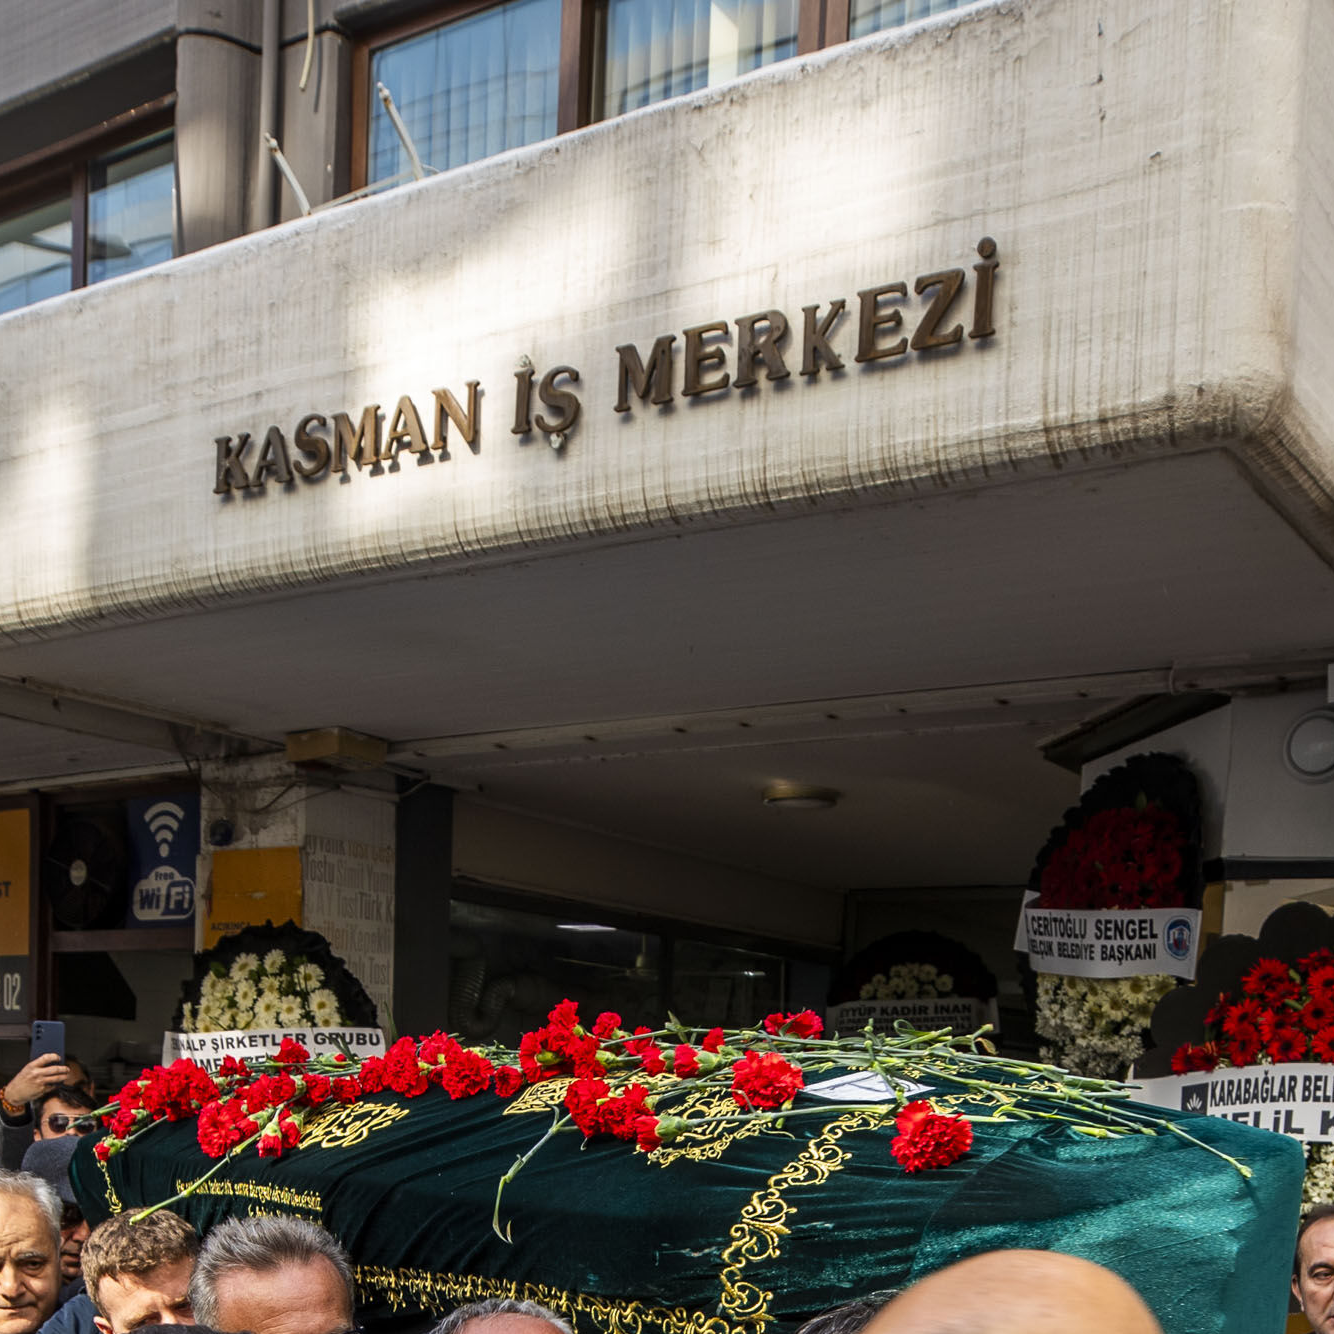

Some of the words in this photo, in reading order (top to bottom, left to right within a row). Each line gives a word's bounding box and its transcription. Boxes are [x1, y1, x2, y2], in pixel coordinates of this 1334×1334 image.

[214, 380, 482, 496] KASMAN
[511, 353, 581, 450] İŞ
[614, 236, 999, 413] MERKEZİ
[155, 870, 174, 881] Free
[1031, 912, 1087, 940] CERİTOĞLU
[1094, 918, 1158, 941] SENGEL
[1058, 940, 1095, 961] BELEDİYE
[1100, 943, 1157, 966] BAŞKANI
[3, 974, 21, 1011] 02
[879, 1002, 929, 1017] KADİR
[933, 1001, 972, 1015] İNAN
[211, 1032, 307, 1055] ŞİRKETLER
[313, 1031, 381, 1047] GRUBU
[1209, 1069, 1297, 1107] KARABAĞLAR
